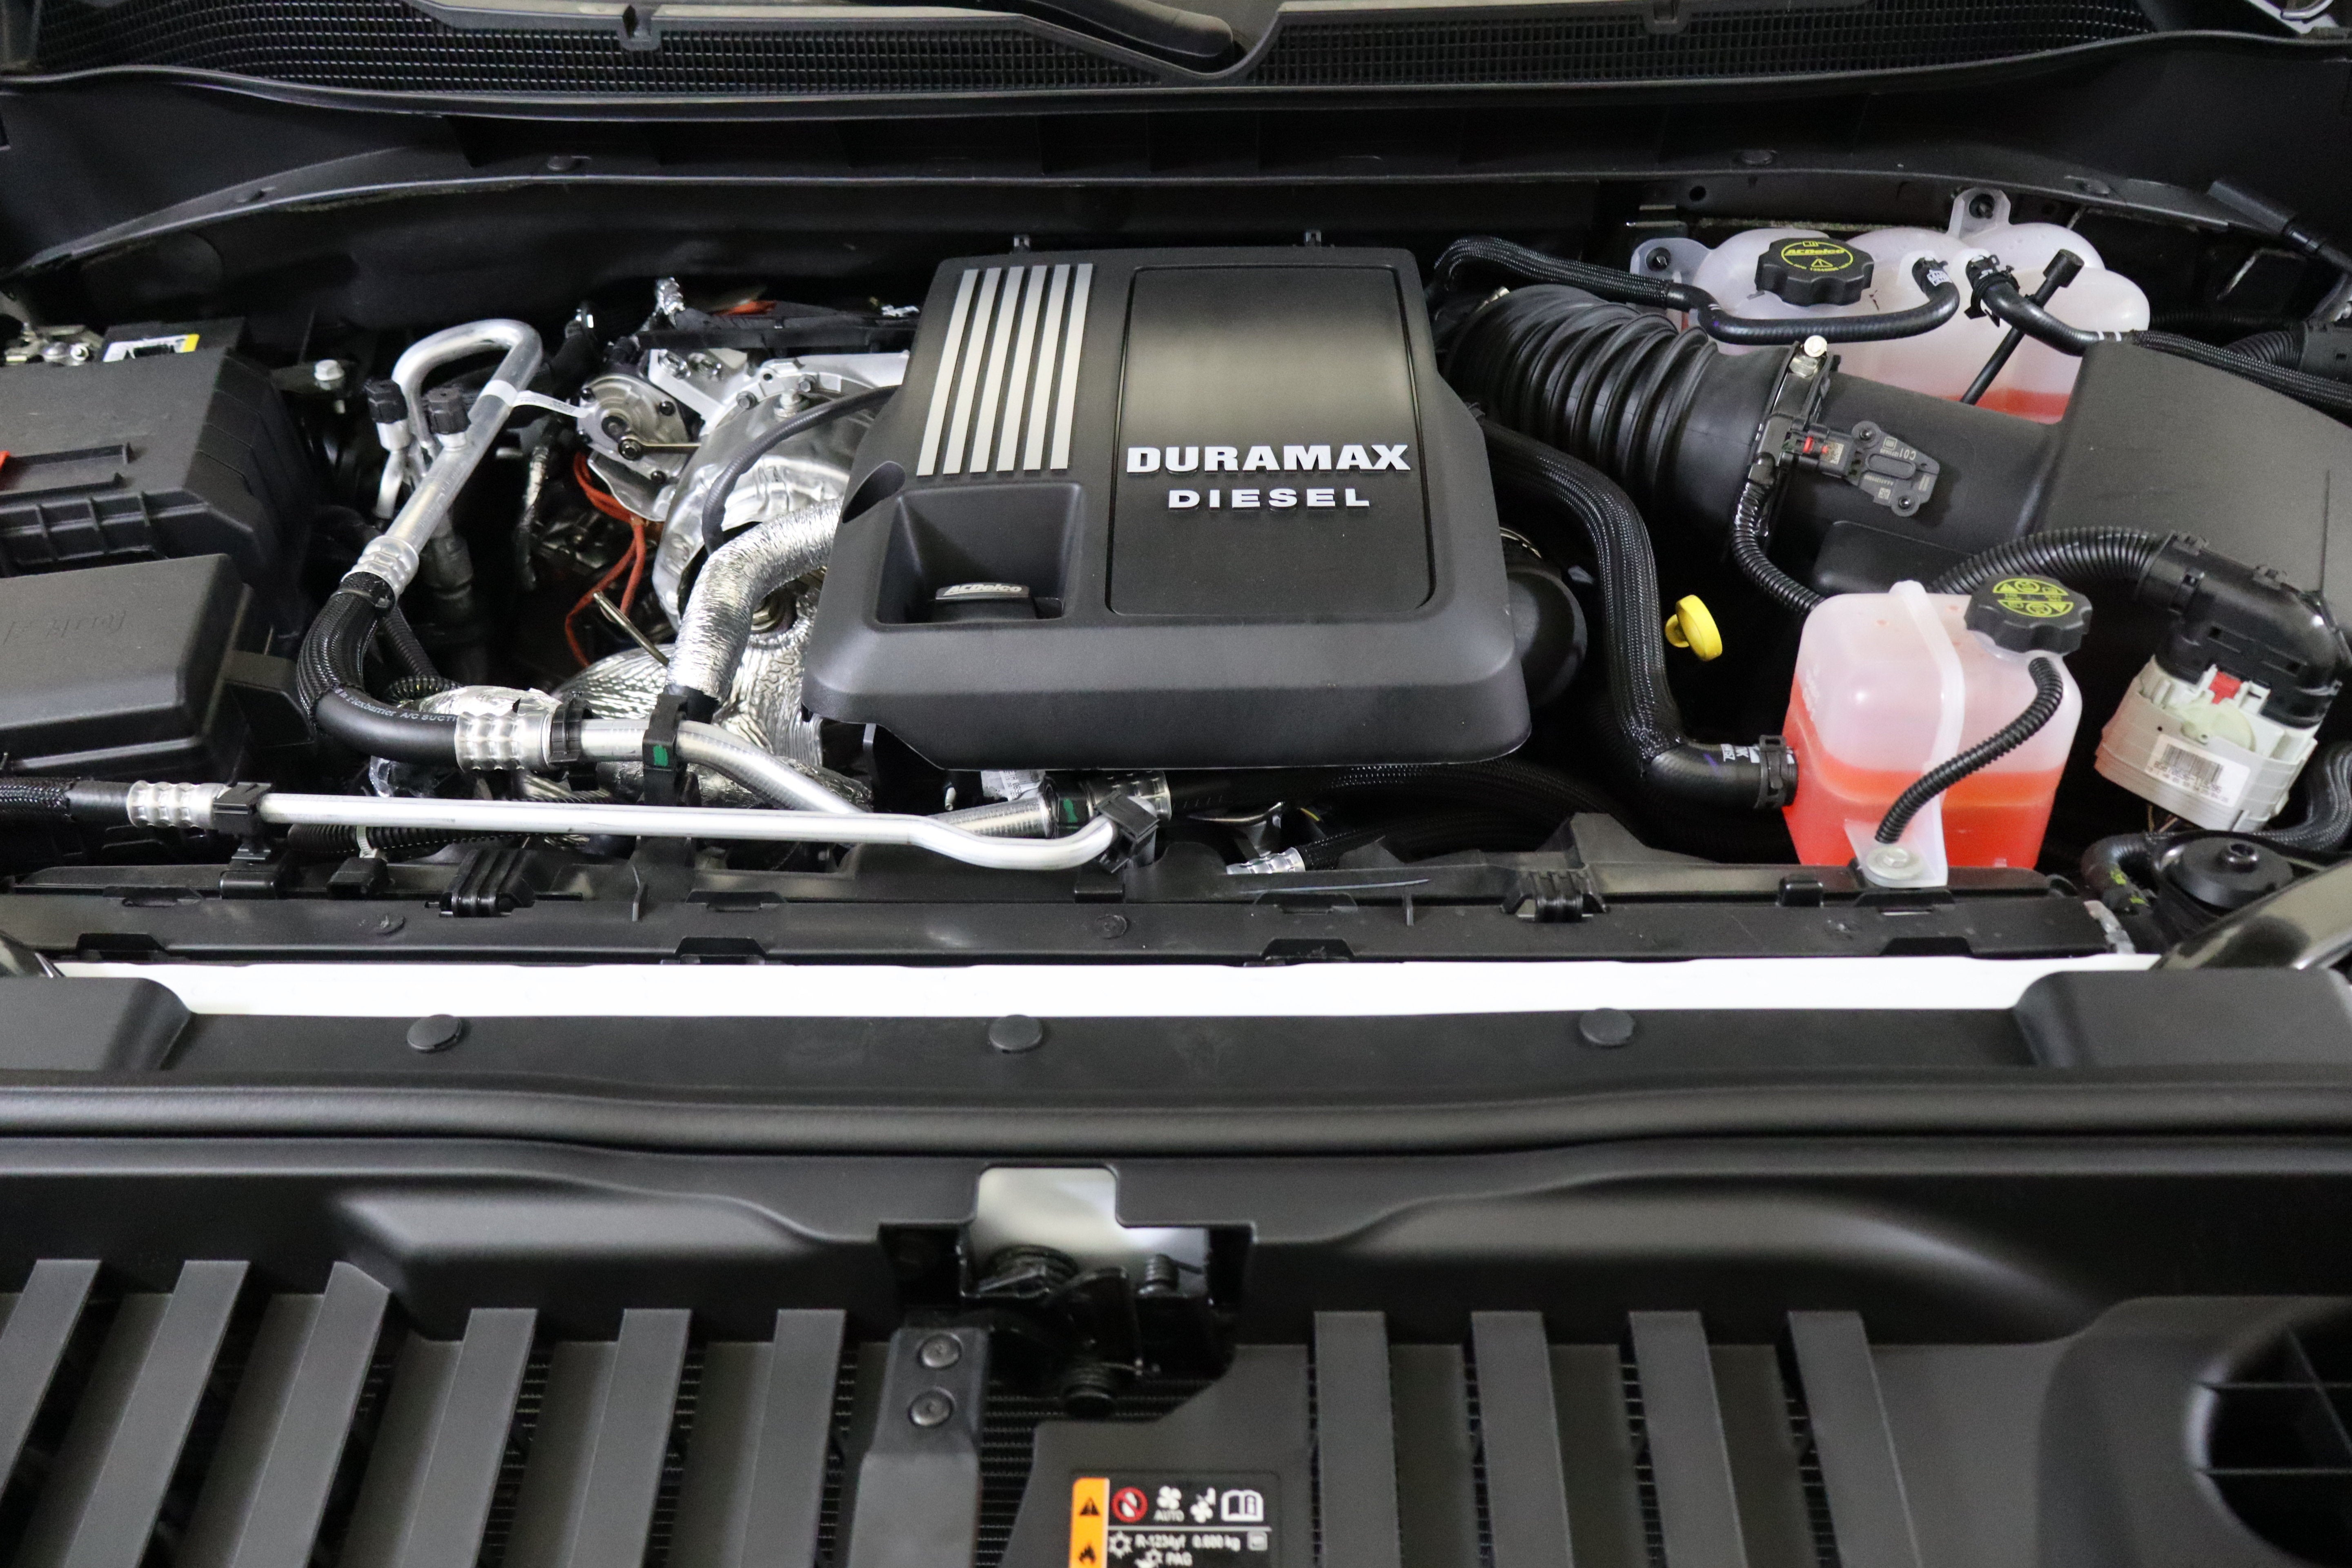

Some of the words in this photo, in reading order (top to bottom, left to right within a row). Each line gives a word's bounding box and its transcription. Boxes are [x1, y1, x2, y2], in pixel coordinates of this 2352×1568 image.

[1127, 445, 1410, 472] DURAMAX
[1899, 448, 1916, 461] C01
[1169, 489, 1370, 508] DIESEL
[943, 584, 1022, 595] ACDelco
[346, 695, 396, 717] Flexbarrier
[1153, 1510, 1185, 1522] AUTO
[1165, 1552, 1193, 1566] PAG
